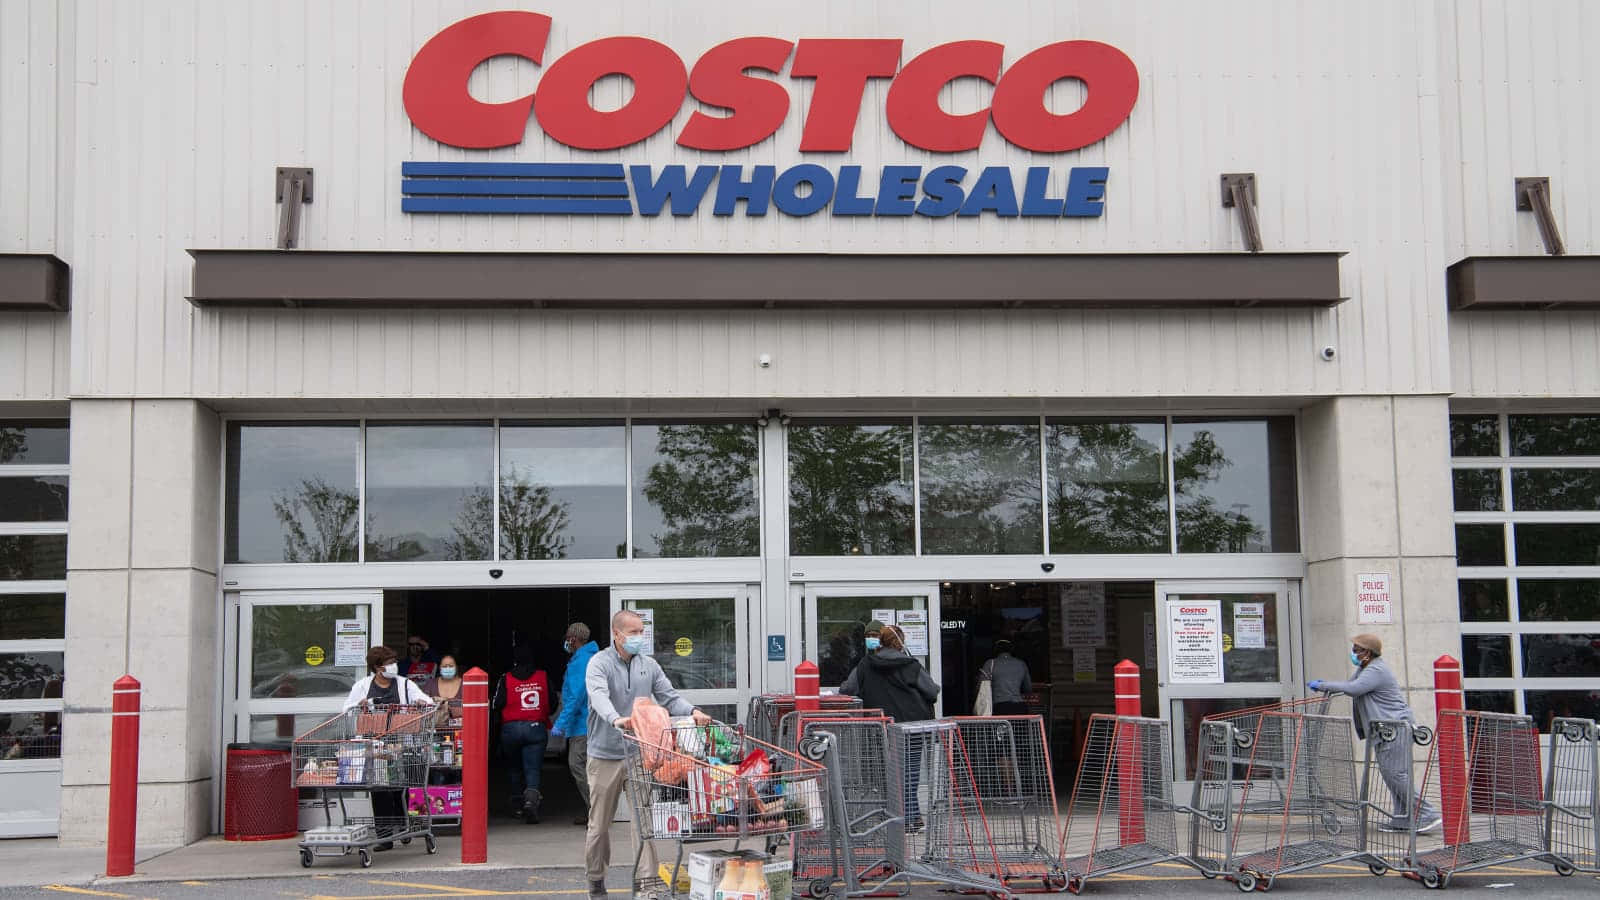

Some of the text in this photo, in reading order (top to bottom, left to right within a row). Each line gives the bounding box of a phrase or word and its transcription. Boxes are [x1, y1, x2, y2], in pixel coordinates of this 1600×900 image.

[402, 10, 1140, 153] COSTCO
[630, 162, 1109, 218] WHOLESALE
[1362, 581, 1385, 590] POLICE
[1359, 593, 1390, 602] SATELLITE
[1364, 604, 1385, 614] OFFICE
[940, 620, 966, 629] QLED TV
